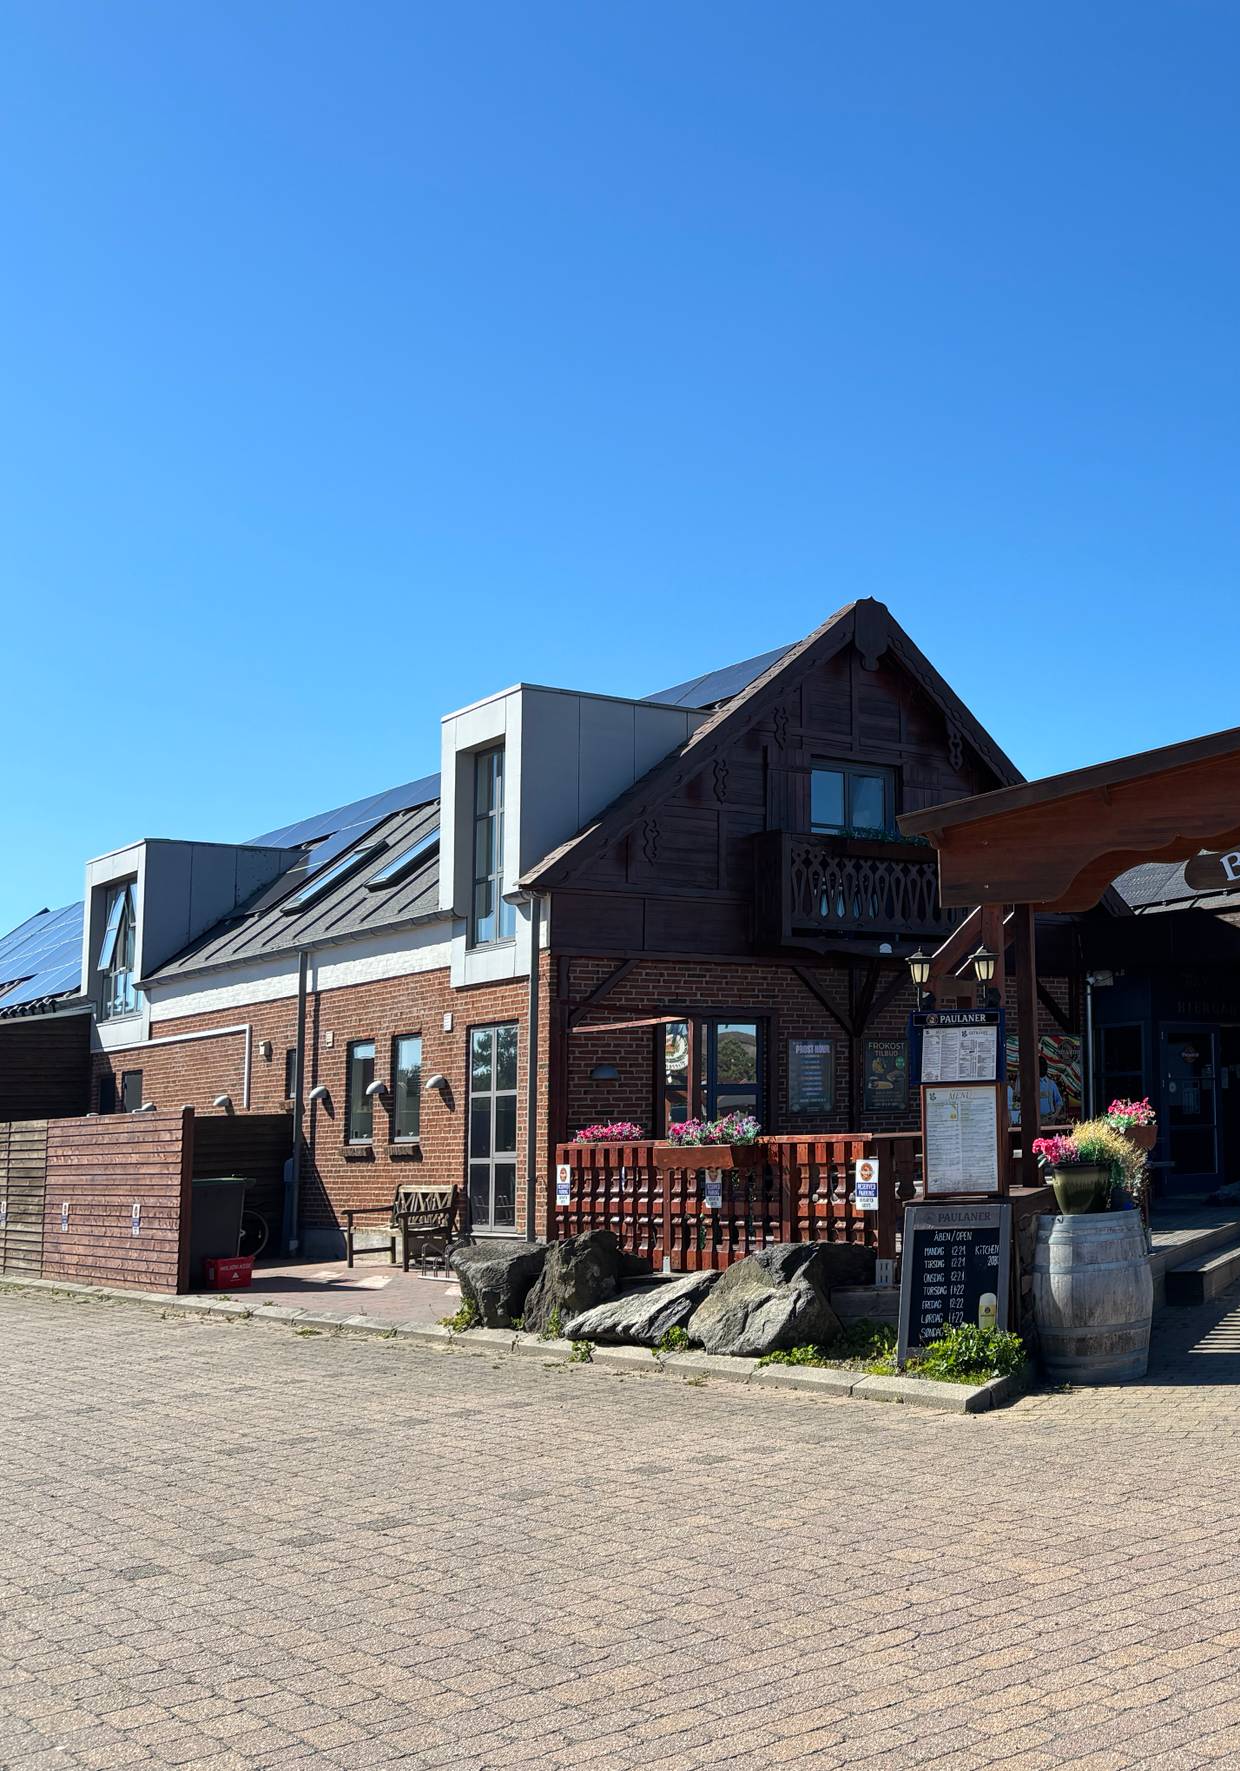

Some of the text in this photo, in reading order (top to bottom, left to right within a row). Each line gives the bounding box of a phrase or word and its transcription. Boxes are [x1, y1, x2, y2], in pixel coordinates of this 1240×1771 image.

[940, 1013, 986, 1024] PAULANER
[868, 1041, 904, 1050] FROKOST
[938, 1211, 991, 1223] PAULANER
[924, 1246, 945, 1256] MANDAG
[975, 1244, 999, 1255] KITCHEN
[924, 1259, 945, 1269] TIRSDAG
[923, 1272, 945, 1283] ONSDAG
[923, 1286, 947, 1296] TORSDAG
[921, 1300, 942, 1309] FREDAG
[920, 1312, 943, 1323] LØRDAG
[920, 1327, 945, 1338] SØNDAG
